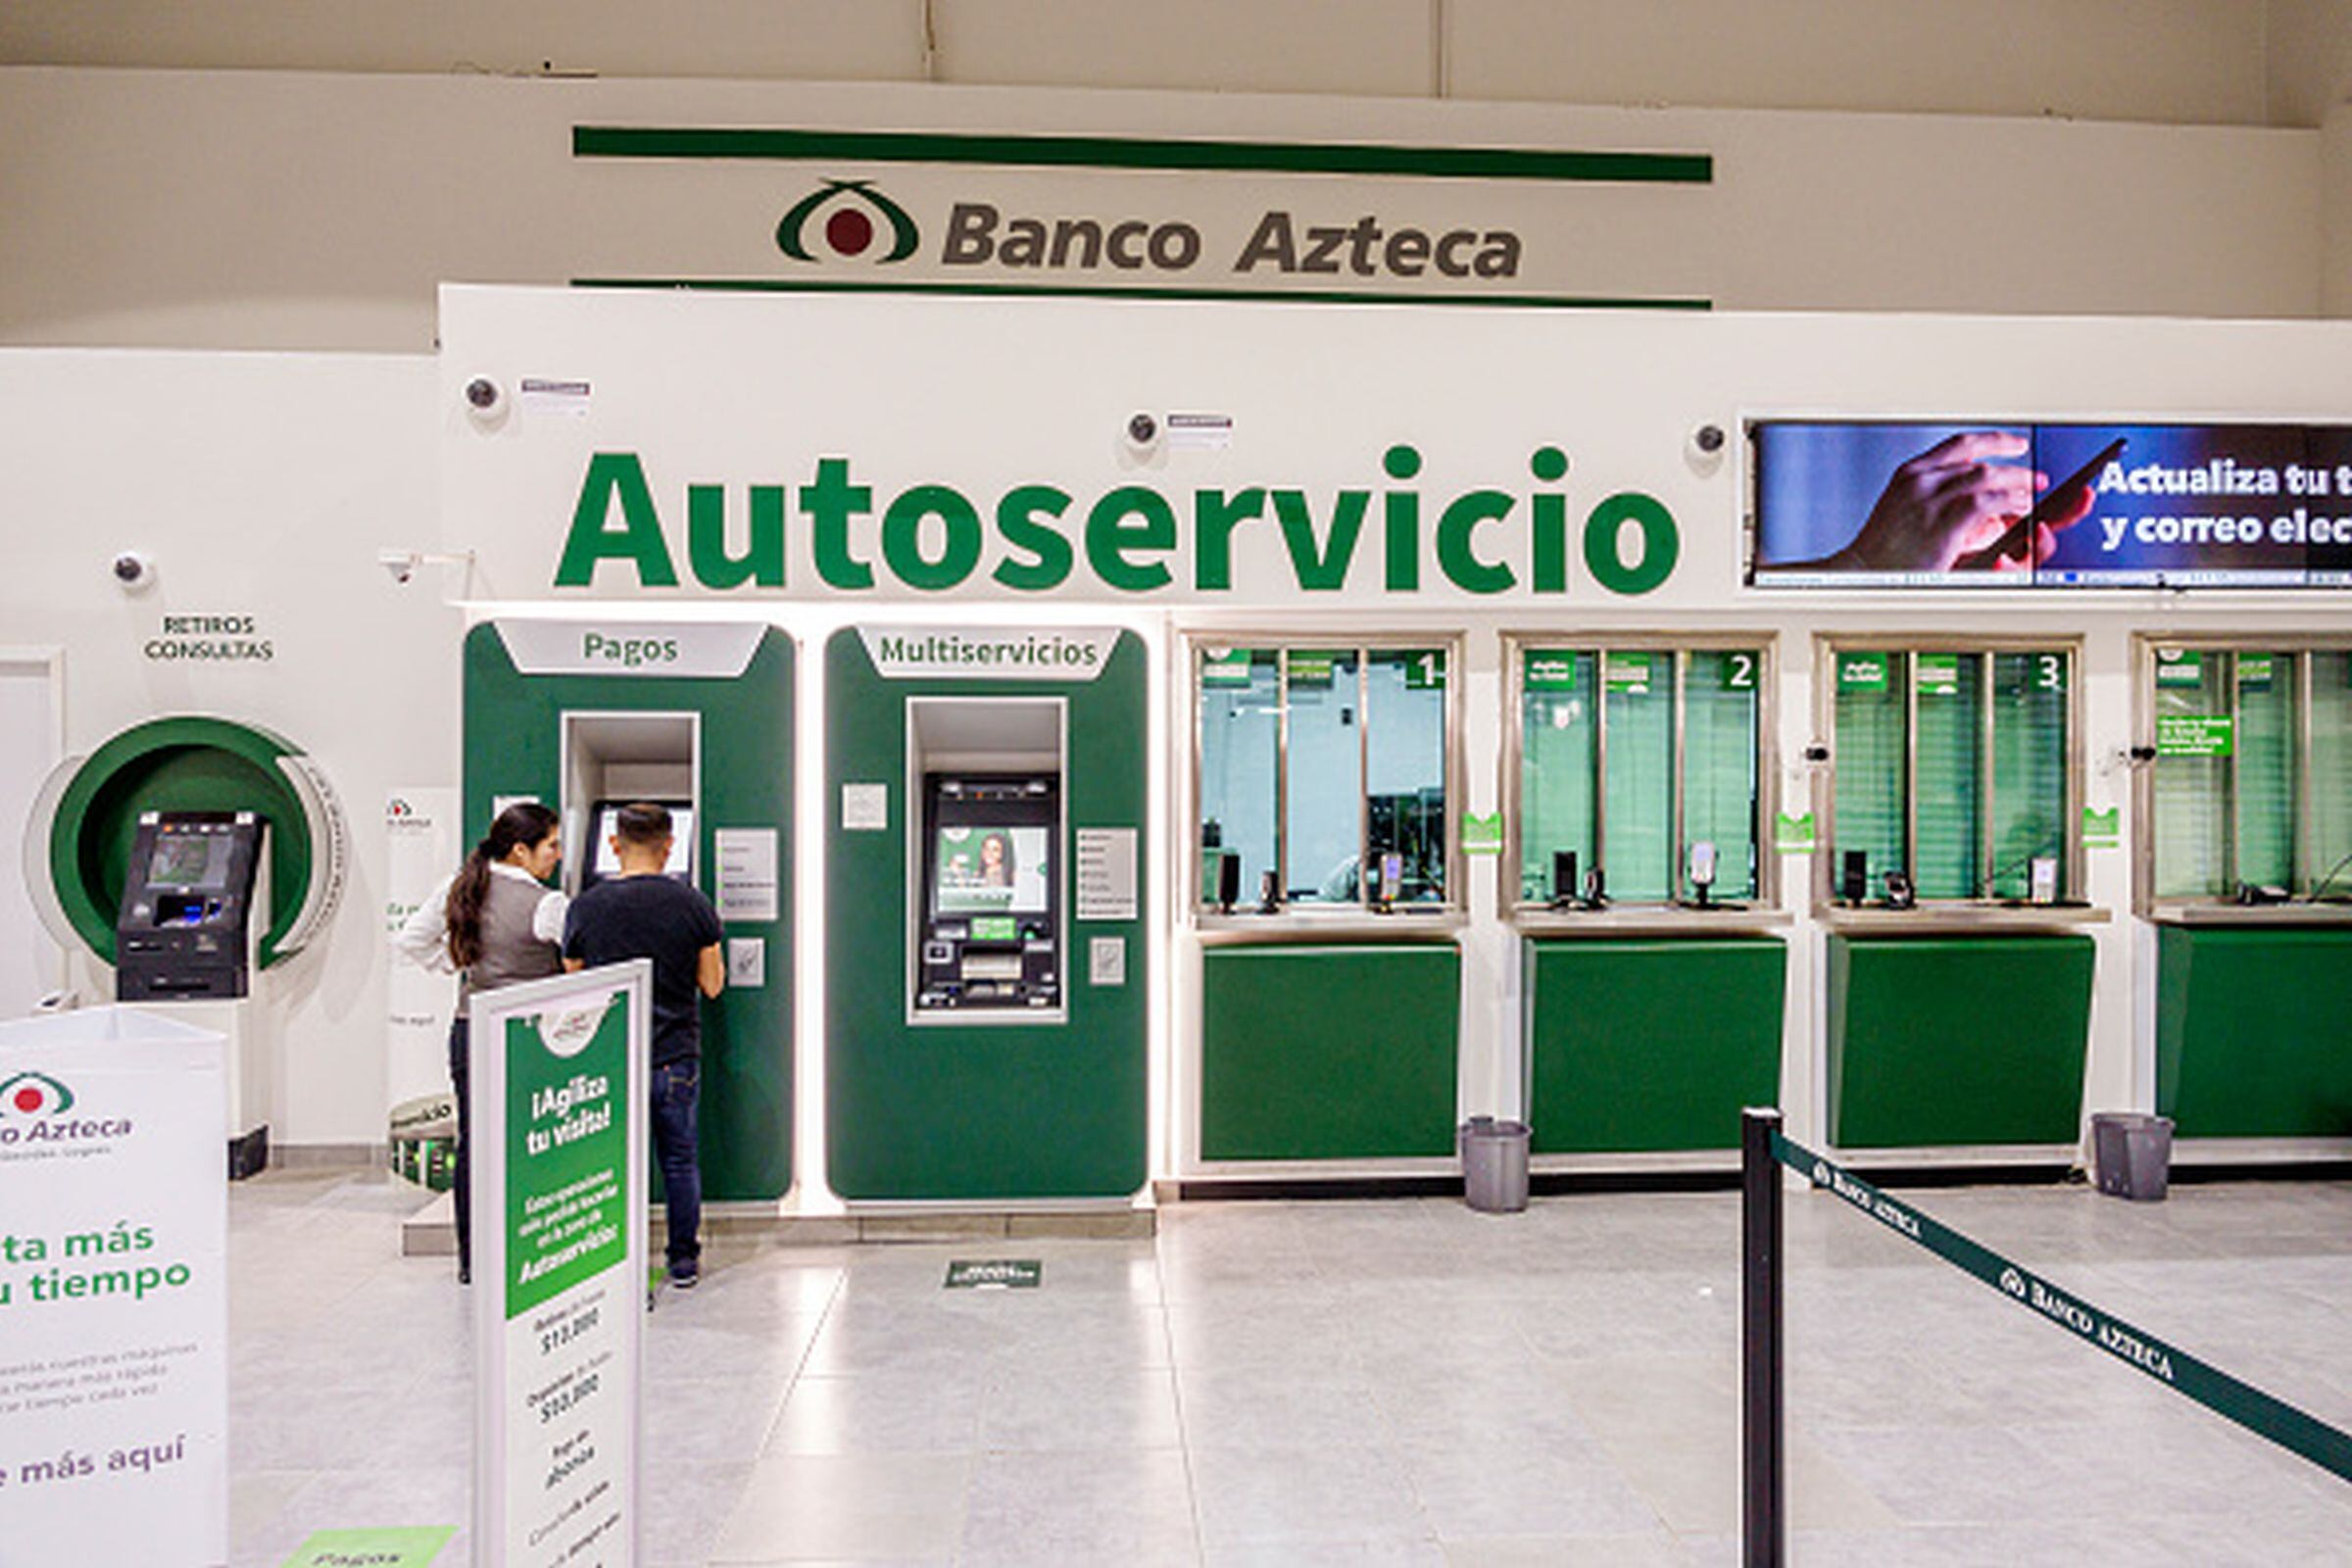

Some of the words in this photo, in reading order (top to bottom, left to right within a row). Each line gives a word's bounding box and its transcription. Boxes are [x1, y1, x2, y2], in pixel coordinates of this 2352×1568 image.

[942, 203, 1200, 270] Banco
[1234, 211, 1522, 278] Azteca
[2098, 458, 2279, 494] Actualiza
[2284, 464, 2329, 494] tu
[554, 444, 1679, 594] Autoservicio
[2099, 516, 2129, 551] y
[2134, 515, 2263, 543] correo
[164, 616, 255, 634] RETIROS
[144, 640, 273, 661] CONSULTAS
[583, 632, 678, 665] Pagos
[880, 637, 1098, 665] Multiservicios
[1418, 655, 1436, 684] 1
[1730, 656, 1752, 686] 2
[2037, 656, 2059, 687] 3
[25, 1119, 133, 1143] Azteca
[526, 1128, 550, 1155] tu
[65, 1219, 155, 1257] más
[29, 1262, 191, 1300] tiempo
[2097, 1325, 2175, 1380] AZTECA
[22, 1449, 95, 1484] más
[108, 1434, 186, 1472] aquí
